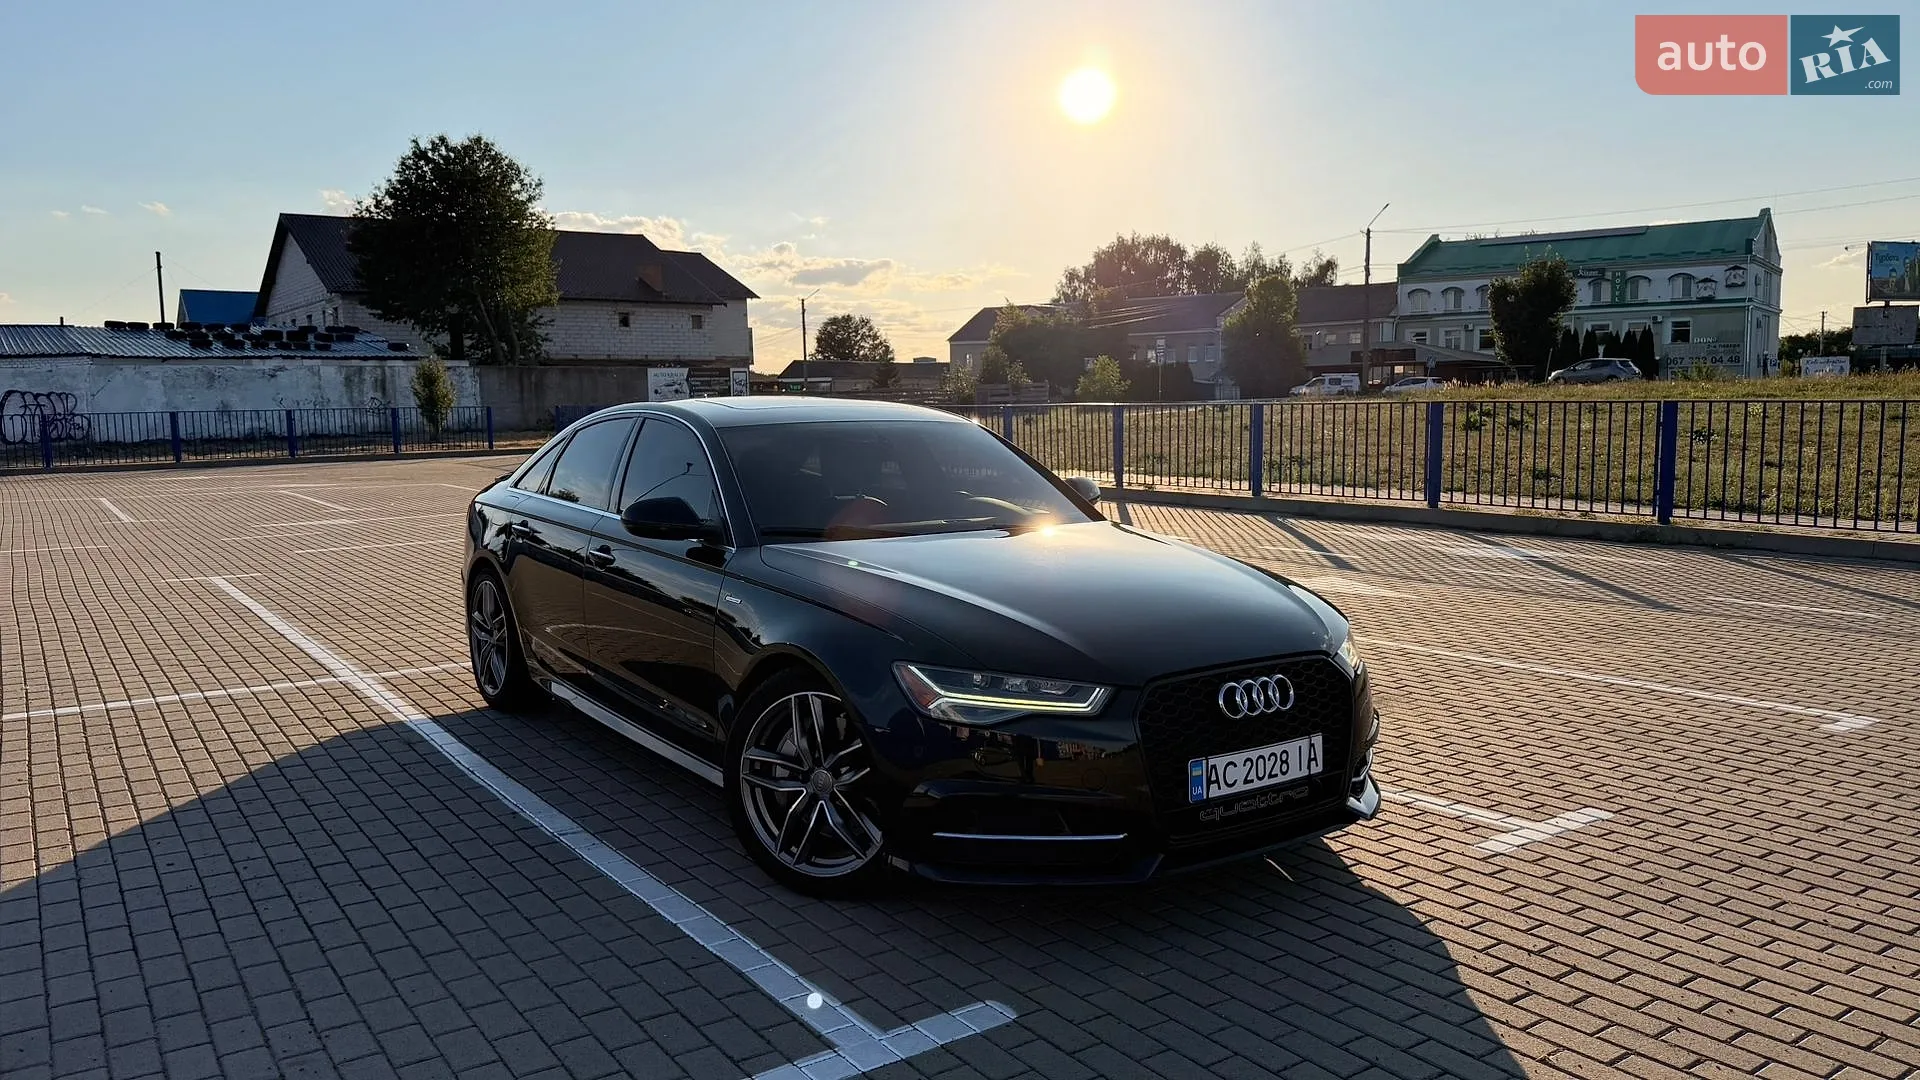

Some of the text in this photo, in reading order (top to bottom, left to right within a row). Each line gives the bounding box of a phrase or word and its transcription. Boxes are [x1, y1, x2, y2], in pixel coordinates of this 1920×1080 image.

[1667, 356, 1684, 366] 067
[1711, 355, 1724, 365] 04
[1727, 354, 1741, 364] 48
[1192, 742, 1319, 795] UA AC 2028 IA
[1200, 786, 1310, 821] quattro
